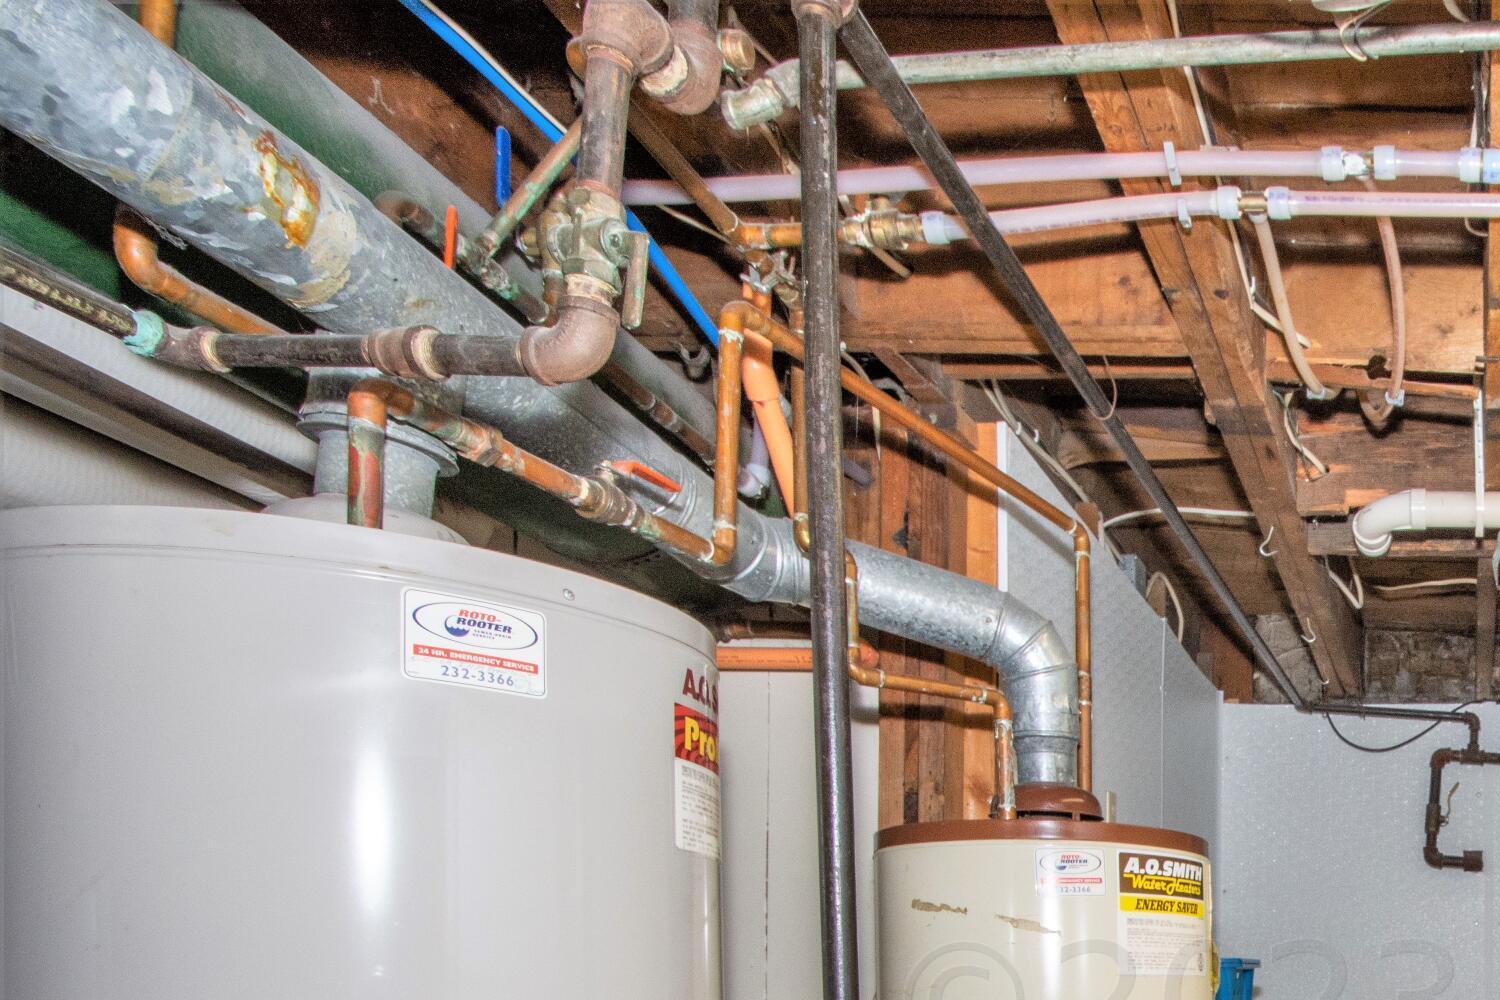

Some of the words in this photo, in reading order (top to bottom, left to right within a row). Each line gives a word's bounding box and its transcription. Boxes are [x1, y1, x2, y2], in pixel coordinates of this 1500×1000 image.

[457, 617, 512, 633] ROOTER
[418, 647, 430, 655] 24
[432, 648, 447, 657] HR.
[450, 651, 501, 665] EMERGENCY
[503, 660, 534, 672] SERVICE
[441, 665, 514, 687] 232-3366
[1123, 873, 1167, 891] Water
[1135, 899, 1176, 912] ENERGY
[1176, 902, 1199, 914] SAVER
